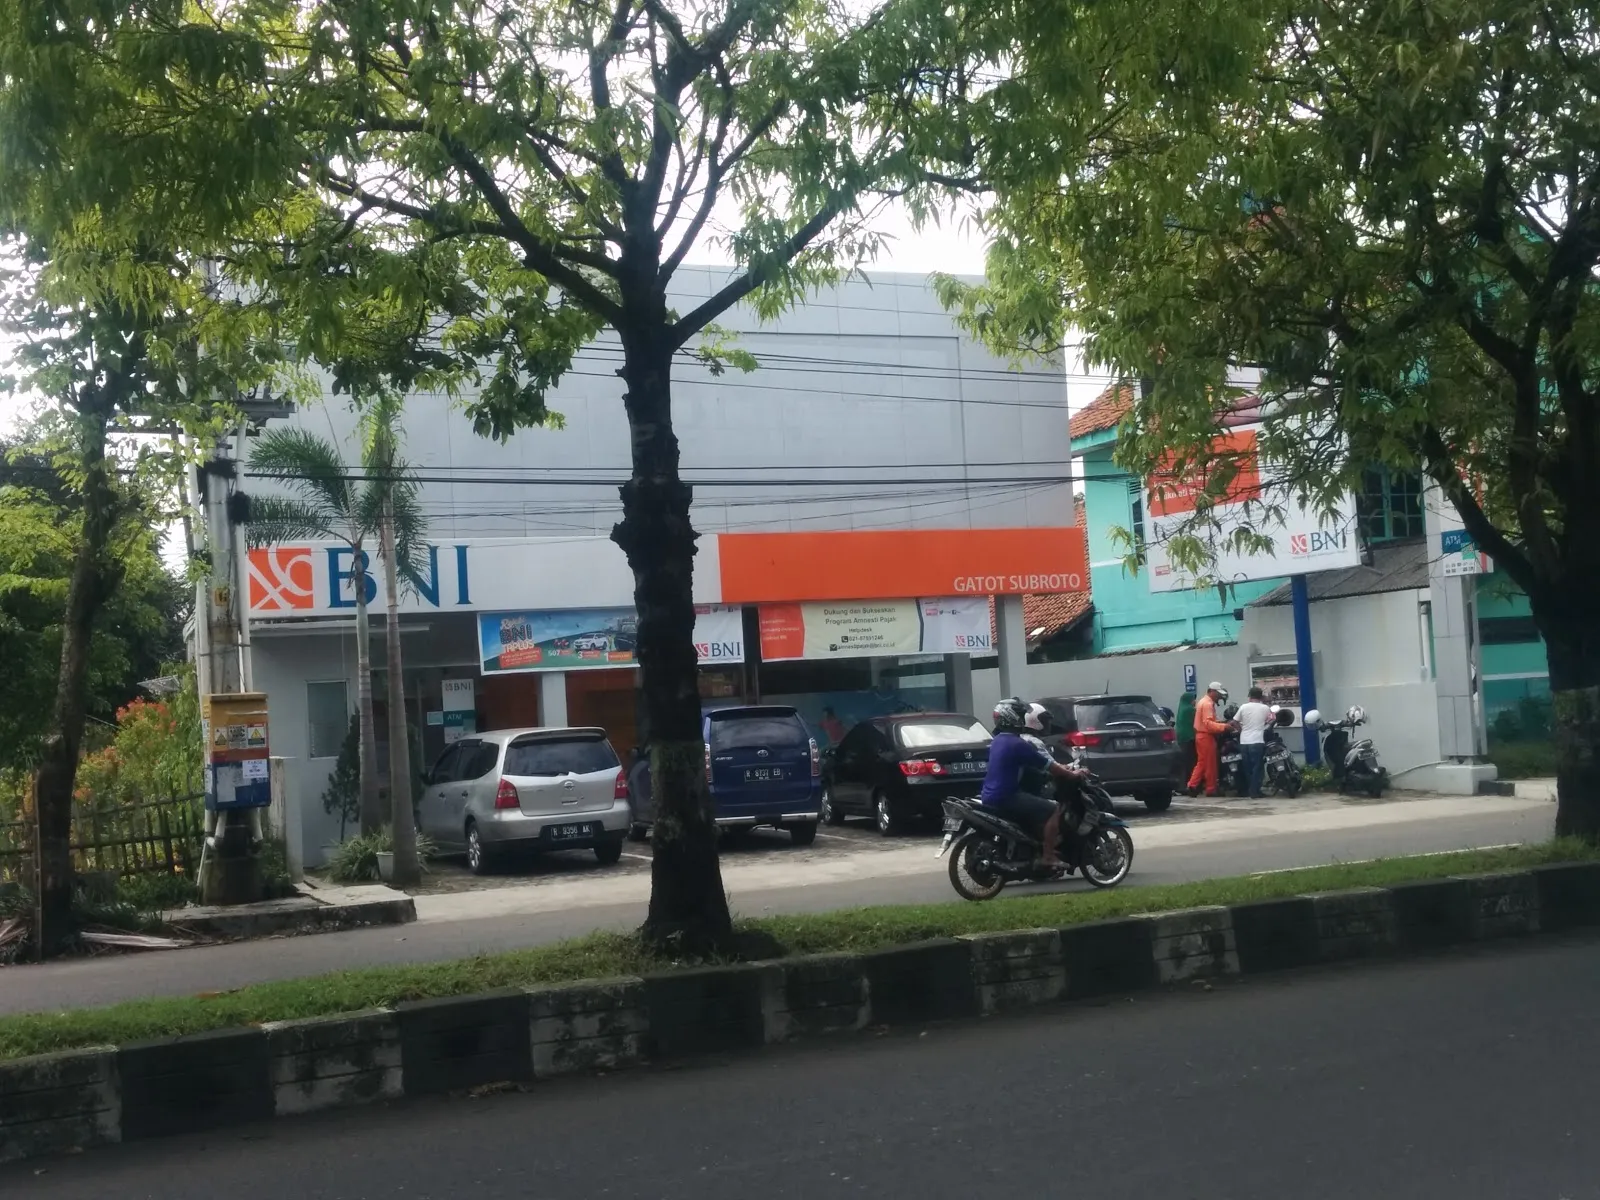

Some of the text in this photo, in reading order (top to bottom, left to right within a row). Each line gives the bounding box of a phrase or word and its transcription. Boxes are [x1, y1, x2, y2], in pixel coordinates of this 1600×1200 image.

[1310, 530, 1347, 552] BNI
[325, 545, 473, 608] BNI
[953, 573, 1081, 592] GATOT SUBROTO
[823, 608, 848, 616] Dukung
[825, 618, 852, 626] Program
[880, 616, 897, 624] Pajak
[967, 635, 990, 647] BNI
[711, 641, 741, 657] BNI
[1185, 665, 1194, 683] P
[453, 682, 471, 691] BNI
[447, 713, 462, 721] ATM
